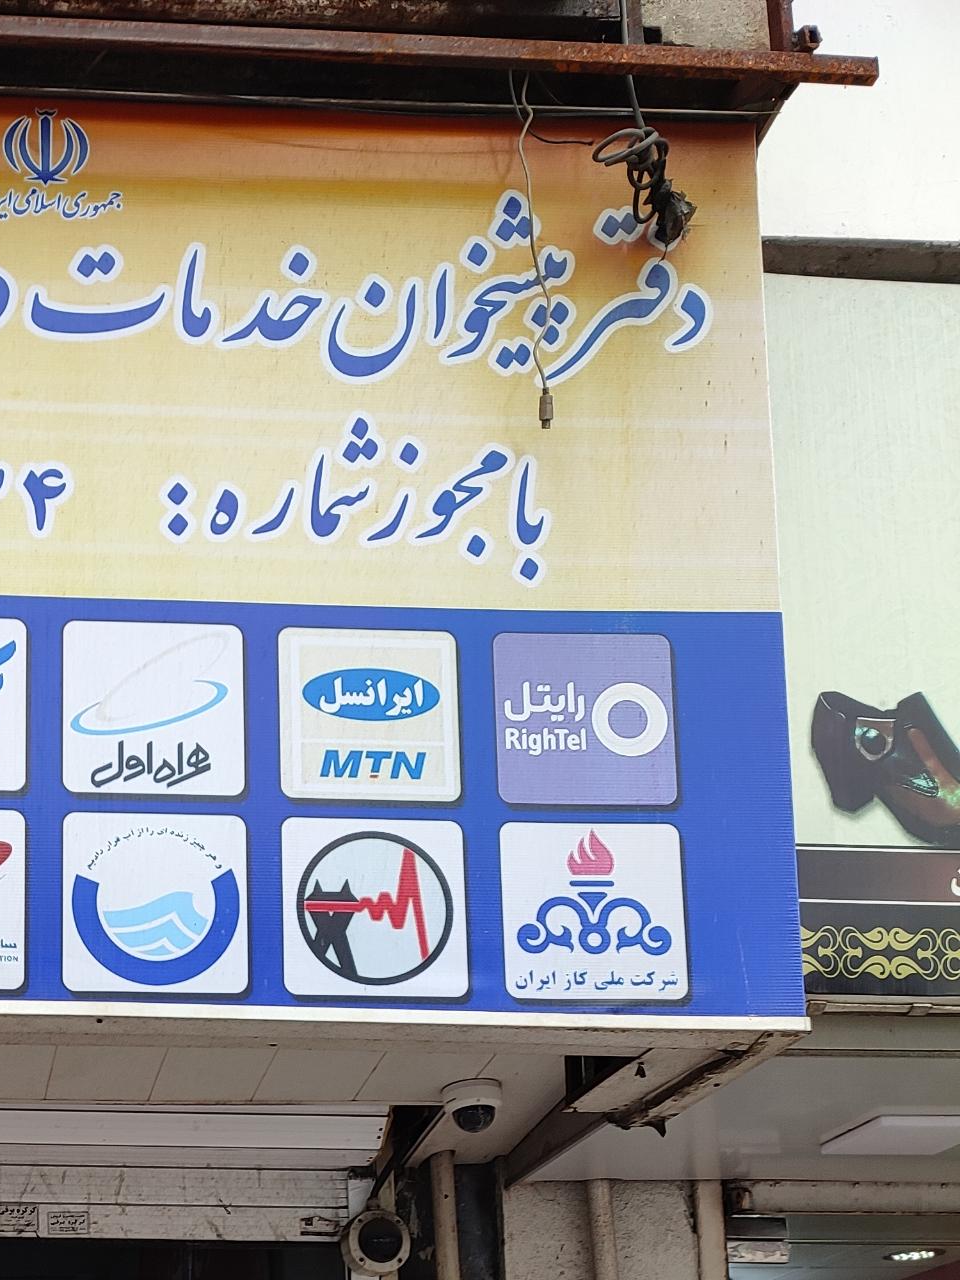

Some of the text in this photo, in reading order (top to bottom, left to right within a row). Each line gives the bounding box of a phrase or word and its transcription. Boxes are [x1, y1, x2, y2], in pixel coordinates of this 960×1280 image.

[13, 188, 61, 215] اسلامی
[62, 191, 123, 219] جمهوری
[30, 245, 323, 342] خدمات
[327, 195, 571, 378] پیشخوان
[545, 212, 710, 381] دفتر
[368, 441, 508, 558] مجوز
[318, 676, 424, 717] ایرانسل
[503, 681, 586, 722] رایتل
[504, 727, 587, 756] RighTel
[90, 740, 153, 788] اول
[319, 750, 427, 780] MTN
[515, 969, 556, 991] ایران
[594, 971, 624, 990] ملی
[630, 971, 679, 991] شرکت
